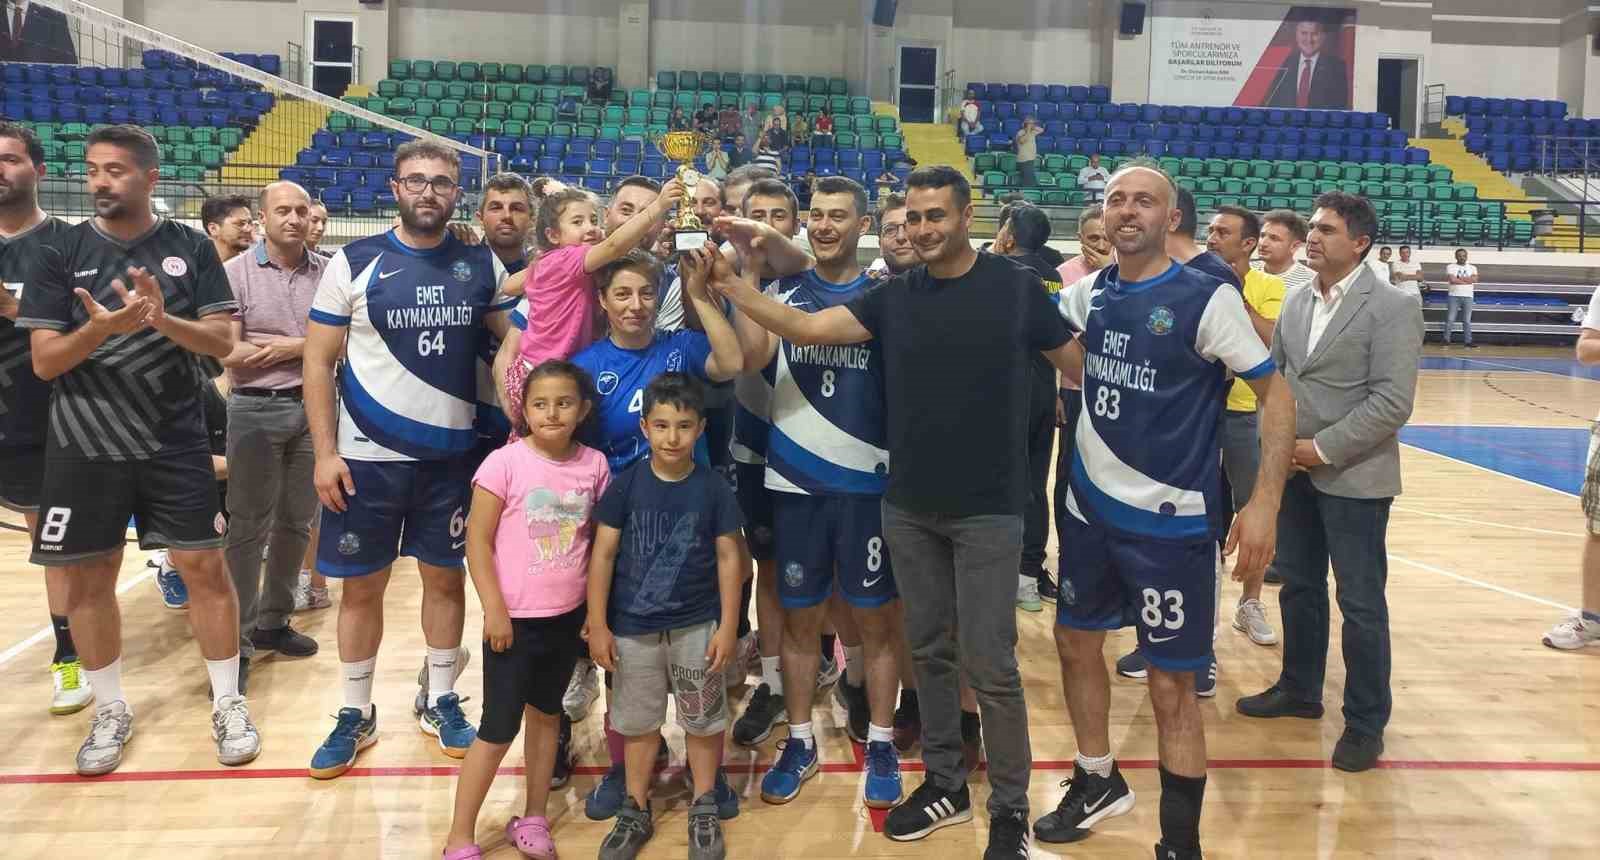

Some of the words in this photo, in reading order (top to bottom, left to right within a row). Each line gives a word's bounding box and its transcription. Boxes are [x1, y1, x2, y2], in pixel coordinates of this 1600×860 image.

[416, 285, 445, 305] EMET
[386, 300, 473, 329] KAYMAKAMLIĞI
[418, 330, 446, 357] 64
[1102, 329, 1131, 359] EMET
[821, 369, 836, 398] 8
[627, 388, 644, 416] 4
[1094, 385, 1121, 420] 83
[40, 506, 72, 542] 8
[449, 505, 468, 538] 6
[867, 536, 882, 572] 8
[1141, 587, 1185, 630] 83
